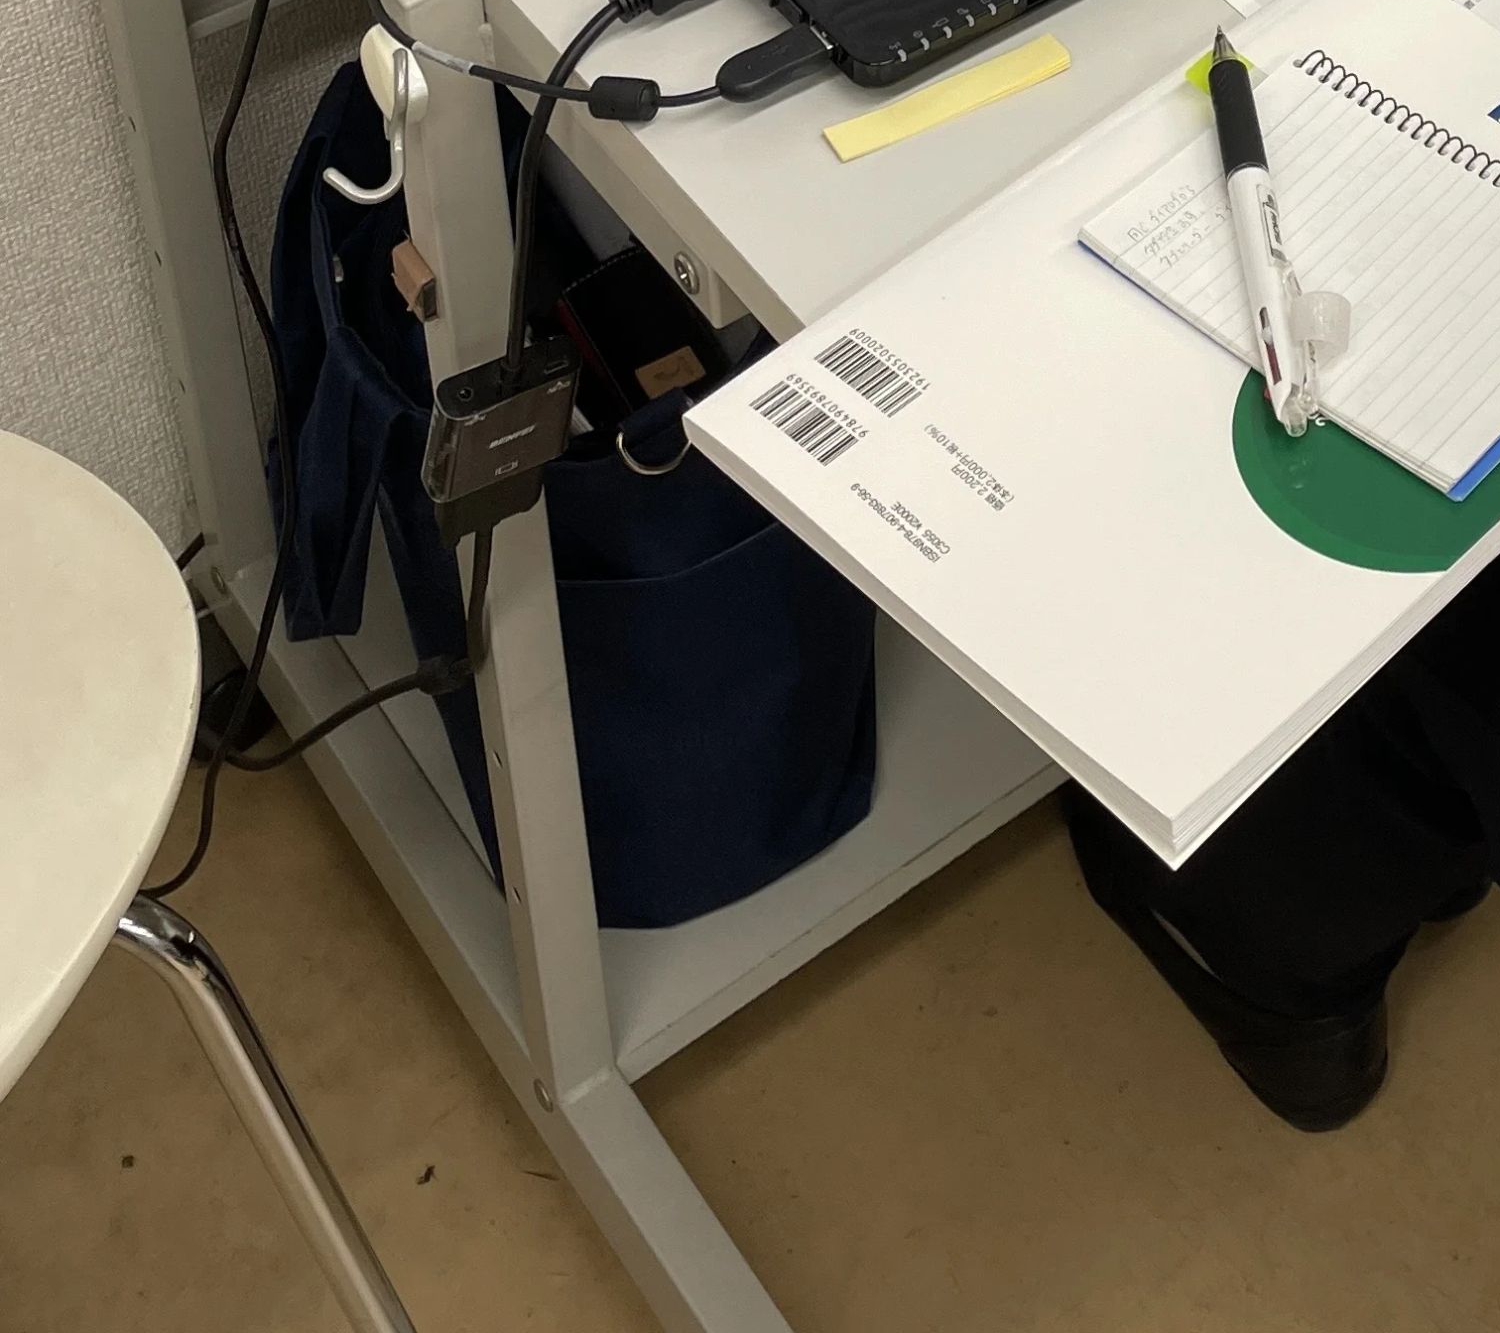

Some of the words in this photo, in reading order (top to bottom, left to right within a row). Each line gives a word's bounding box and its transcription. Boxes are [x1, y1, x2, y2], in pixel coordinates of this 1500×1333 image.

[847, 327, 931, 391] 1923055020009
[785, 372, 870, 438] 9784907893569
[950, 462, 990, 499] 2,200円
[984, 491, 1008, 513] 価格
[923, 530, 951, 555] C3055
